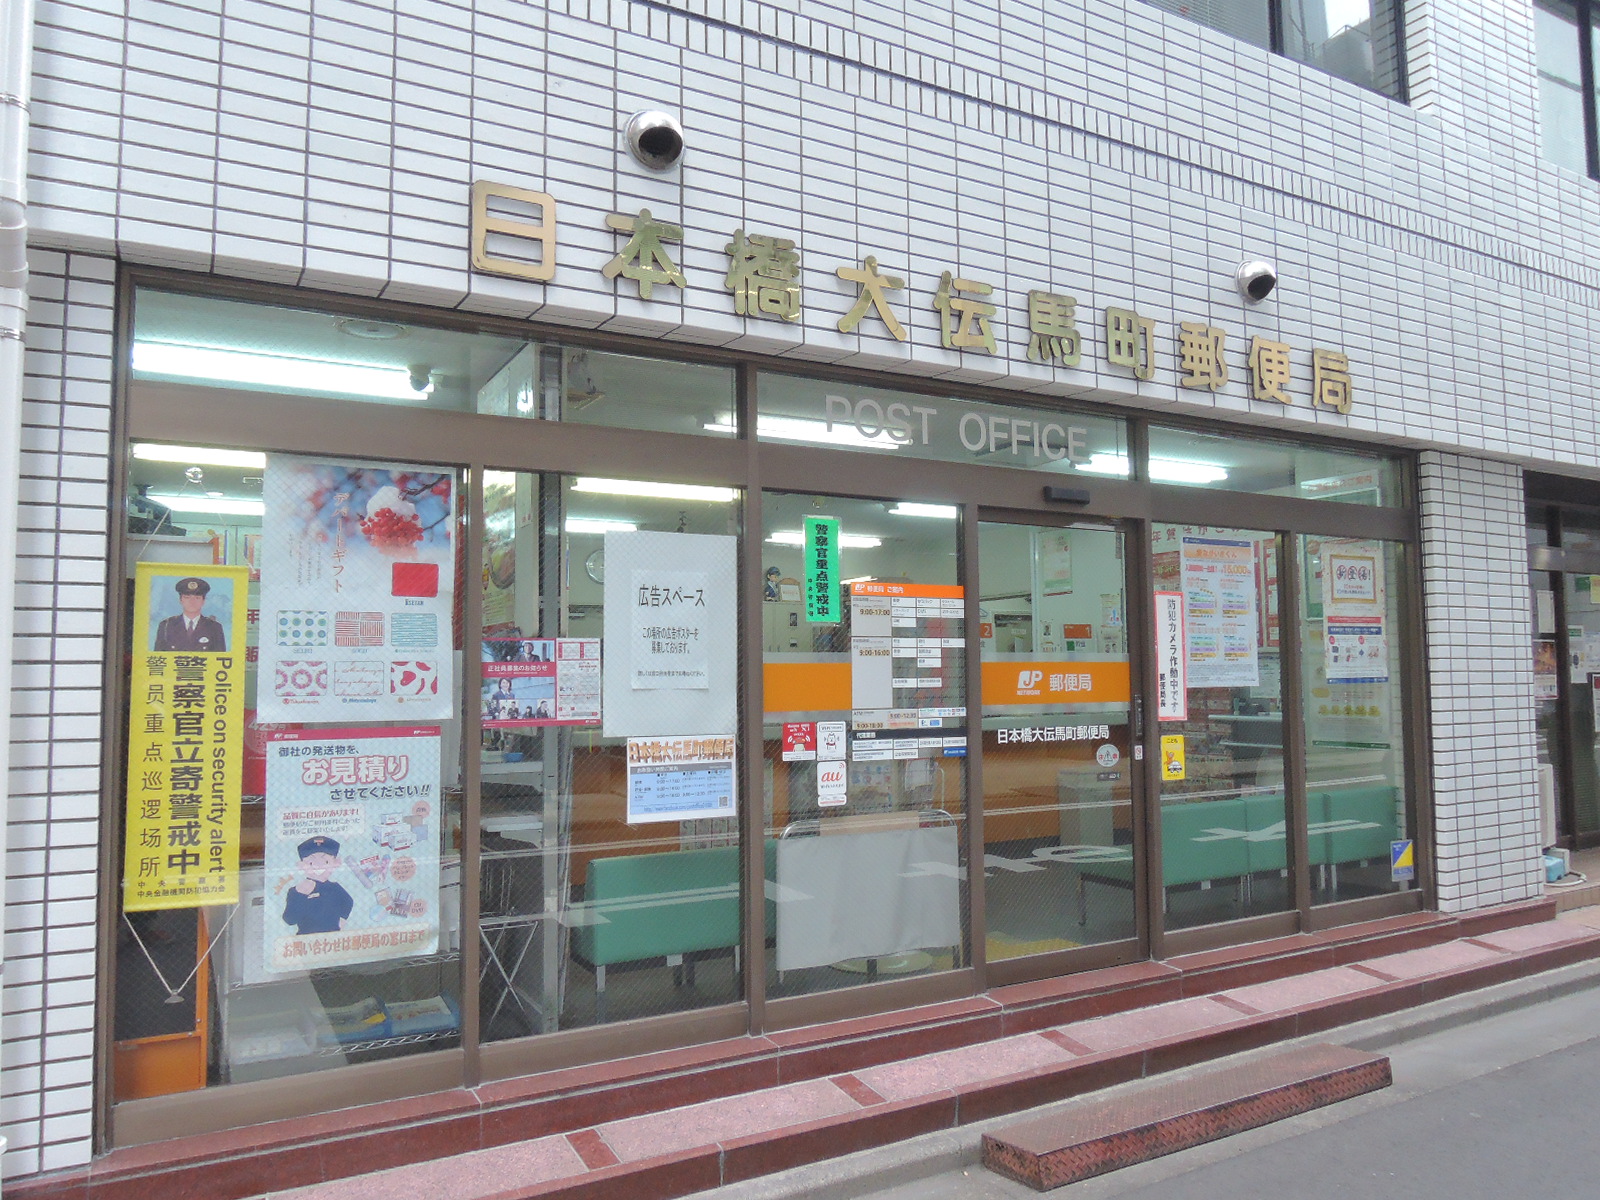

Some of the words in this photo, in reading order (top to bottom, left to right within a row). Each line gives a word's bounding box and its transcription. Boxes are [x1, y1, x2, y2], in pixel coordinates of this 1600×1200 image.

[472, 179, 1352, 415] 日本橋大伝馬町郵便局
[824, 395, 937, 445] POST
[959, 413, 1088, 461] OFFICE
[638, 584, 705, 607] 広告スペース
[1167, 599, 1178, 713] 防犯カメラ作動中です
[214, 657, 232, 715] Police
[1049, 674, 1092, 692] 郵便局
[213, 719, 227, 744] on
[997, 725, 1110, 744] 日本橋大伝馬町郵便局
[138, 656, 167, 878] 警员重点巡逻场所
[168, 656, 207, 875] 警察官立寄警戒中
[278, 745, 359, 757] 御社の発送物を、
[207, 747, 228, 825] security
[302, 754, 409, 786] お見積り
[822, 772, 842, 783] au
[331, 784, 430, 800] させてください!!
[209, 829, 226, 873] alert
[282, 929, 425, 957] お問い合わせは郵便局の窓口まで
